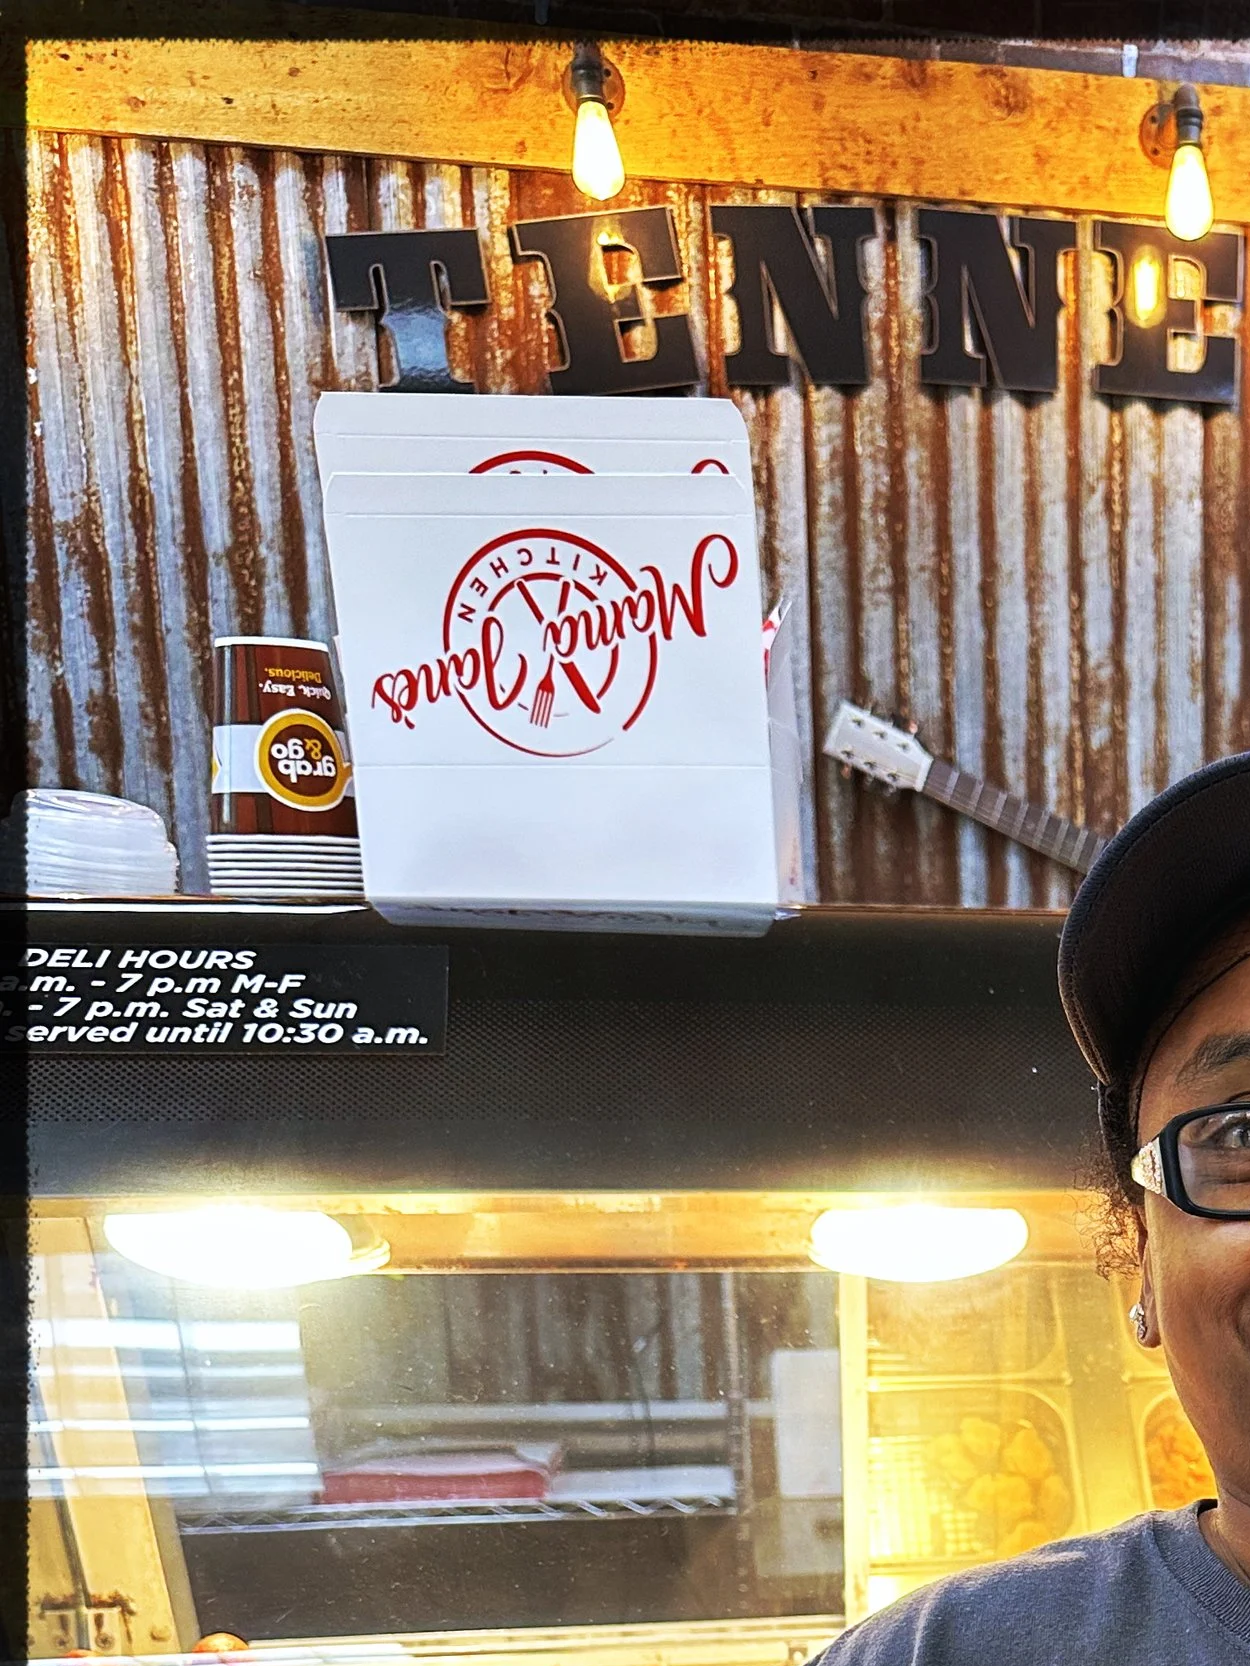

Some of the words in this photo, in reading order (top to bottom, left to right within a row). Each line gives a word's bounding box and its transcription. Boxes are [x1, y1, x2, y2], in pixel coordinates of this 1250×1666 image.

[456, 546, 609, 624] KITCHEN
[543, 533, 739, 658] Mama
[263, 667, 321, 684] Delicious.
[371, 616, 528, 730] Jane's
[258, 680, 296, 698] Easy.
[270, 738, 305, 760] go
[304, 738, 323, 760] &
[277, 755, 337, 783] grab
[19, 948, 111, 968] DELI
[118, 949, 257, 970] HOURS
[115, 974, 144, 993] 7
[146, 977, 222, 997] p.m
[230, 973, 306, 994] M-F
[53, 997, 82, 1017] 7
[84, 1001, 169, 1021] p.m.
[182, 998, 246, 1019] Sat
[252, 997, 280, 1019] &
[288, 998, 358, 1019] Sun
[145, 1023, 234, 1043] until
[242, 1022, 344, 1044] 10:30
[352, 1027, 428, 1045] a.m.
